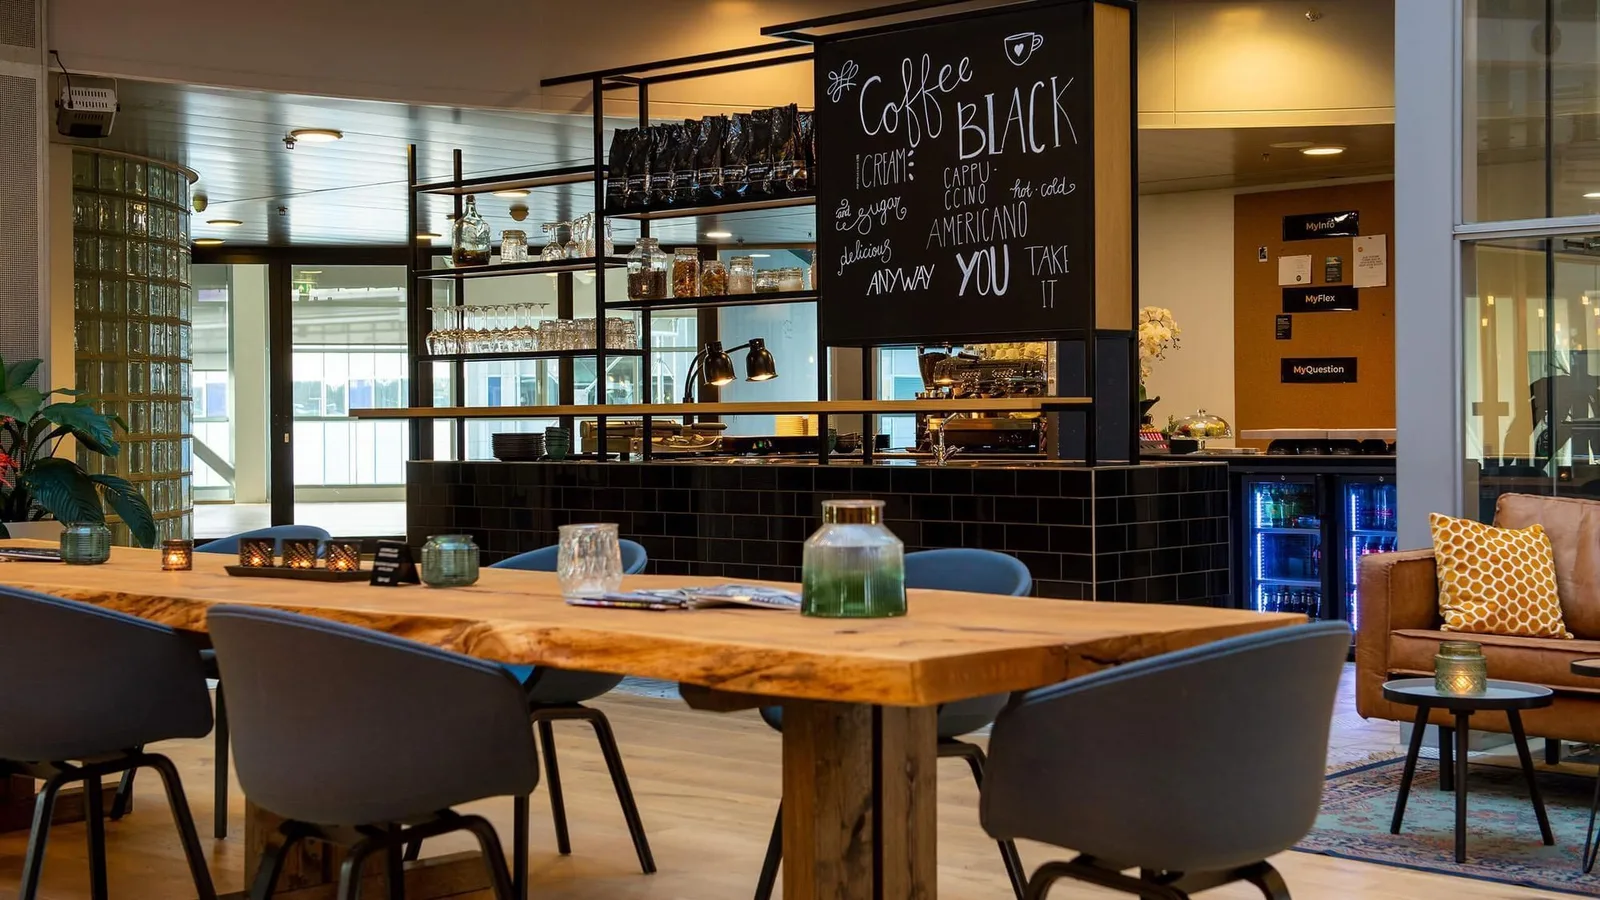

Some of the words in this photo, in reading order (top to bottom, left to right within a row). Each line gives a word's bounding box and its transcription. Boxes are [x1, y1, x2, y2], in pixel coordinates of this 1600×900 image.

[860, 53, 973, 148] Coffee
[957, 75, 1078, 160] BLACK
[944, 183, 987, 210] CCINO
[1010, 179, 1033, 198] hot
[1040, 176, 1076, 197] cold
[836, 196, 907, 235] sugar
[926, 200, 1028, 250] AMERICANO
[1306, 220, 1335, 231] MyInfo
[837, 239, 892, 276] delicious
[955, 244, 1010, 297] YOU
[1024, 245, 1070, 276] TAKE
[866, 264, 935, 296] ANYWAY
[1041, 279, 1058, 309] IT
[1305, 294, 1335, 304] MyFlex
[1293, 365, 1344, 375] MyQuestion
